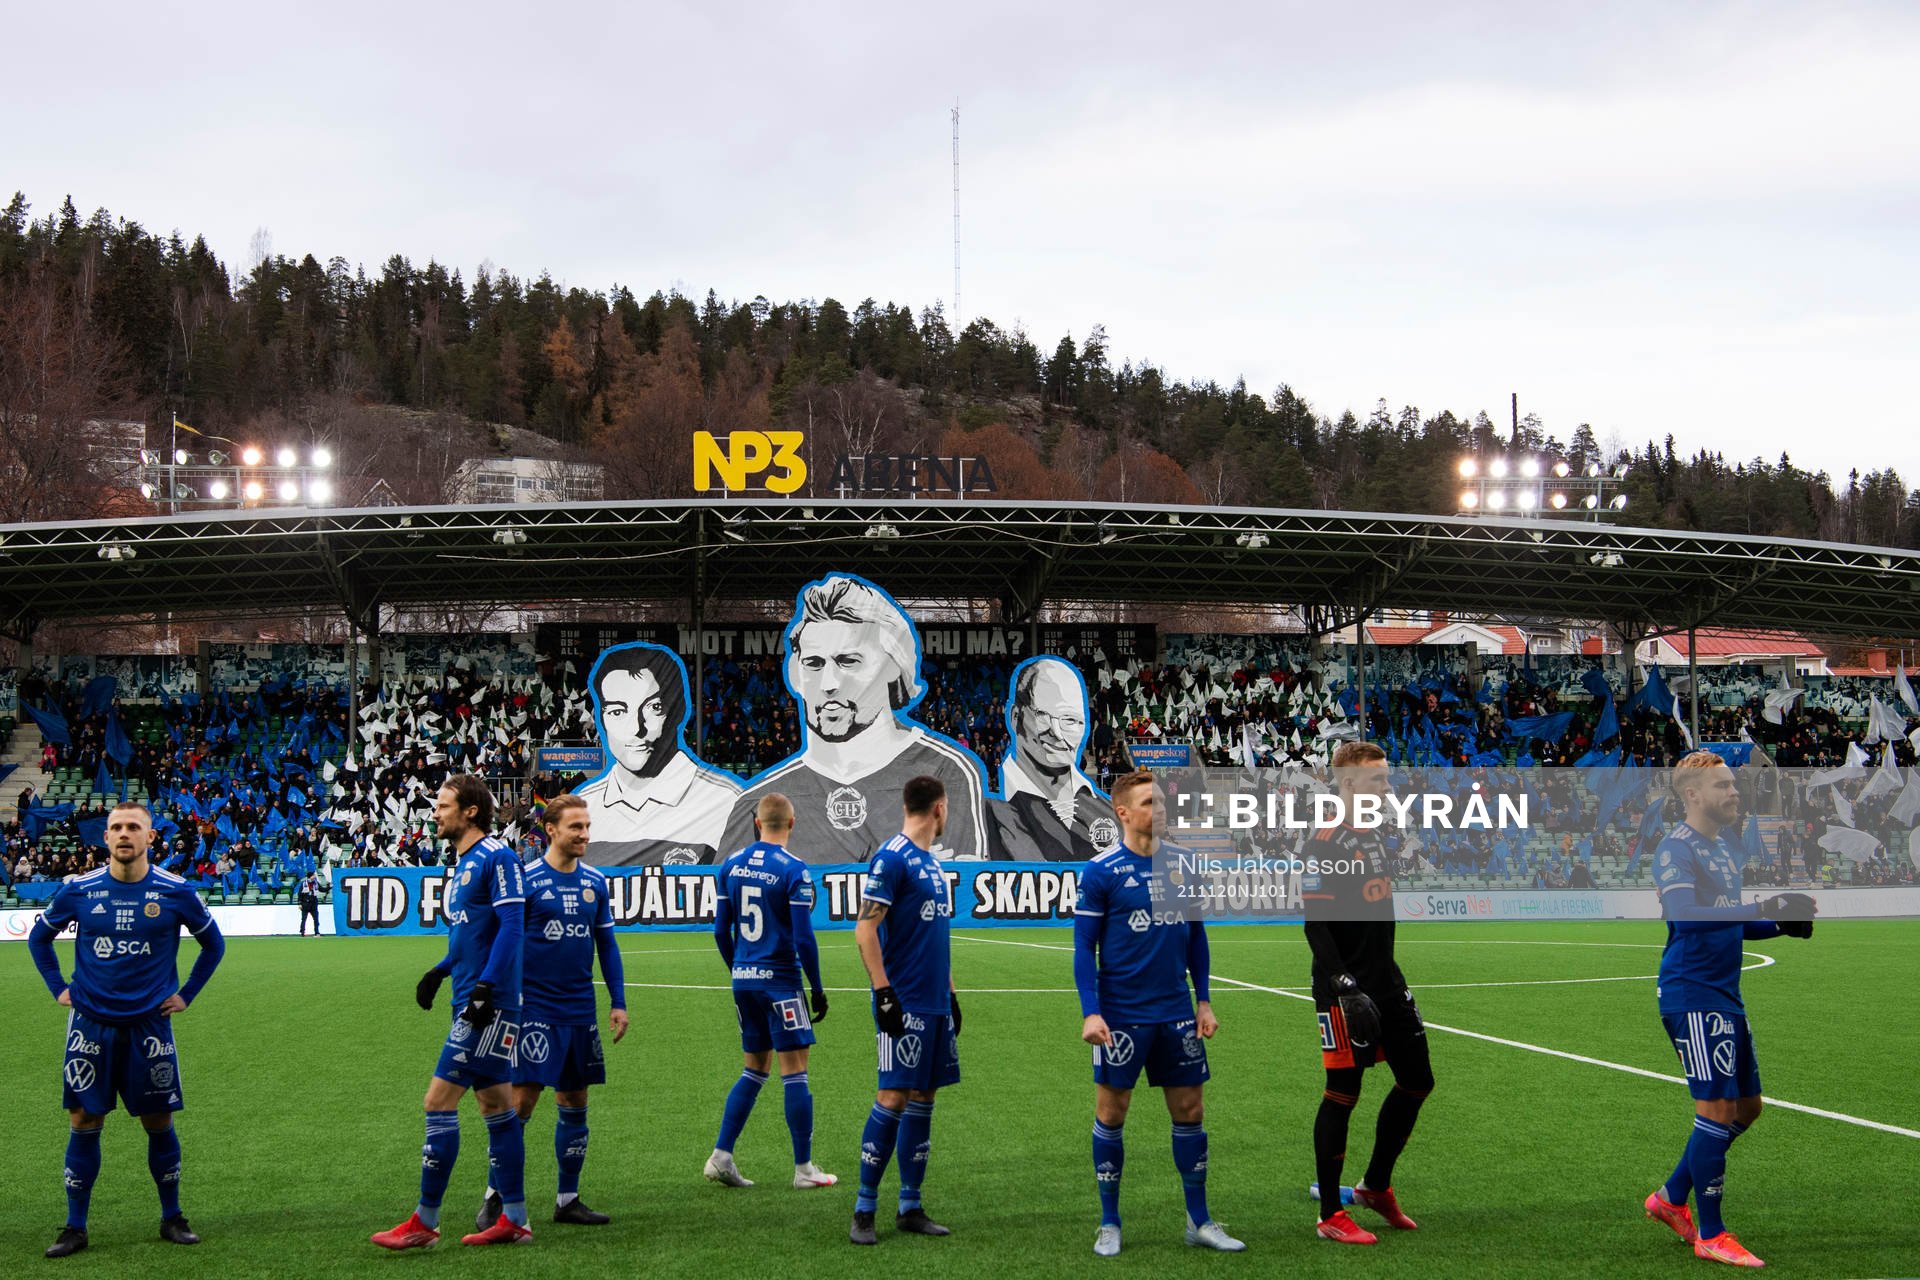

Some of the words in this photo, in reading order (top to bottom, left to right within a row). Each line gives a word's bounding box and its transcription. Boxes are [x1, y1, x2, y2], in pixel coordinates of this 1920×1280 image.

[693, 430, 807, 493] NP3
[827, 454, 997, 492] ARENA
[543, 751, 599, 762] wangeskog
[344, 876, 407, 924] TID
[975, 871, 1077, 914] SKAPA
[1428, 895, 1492, 916] ServaNet
[740, 885, 763, 942] 5
[1153, 910, 1185, 926] SCA
[566, 924, 591, 937] SCA
[117, 941, 151, 955] SCA
[69, 1029, 101, 1055] Diös
